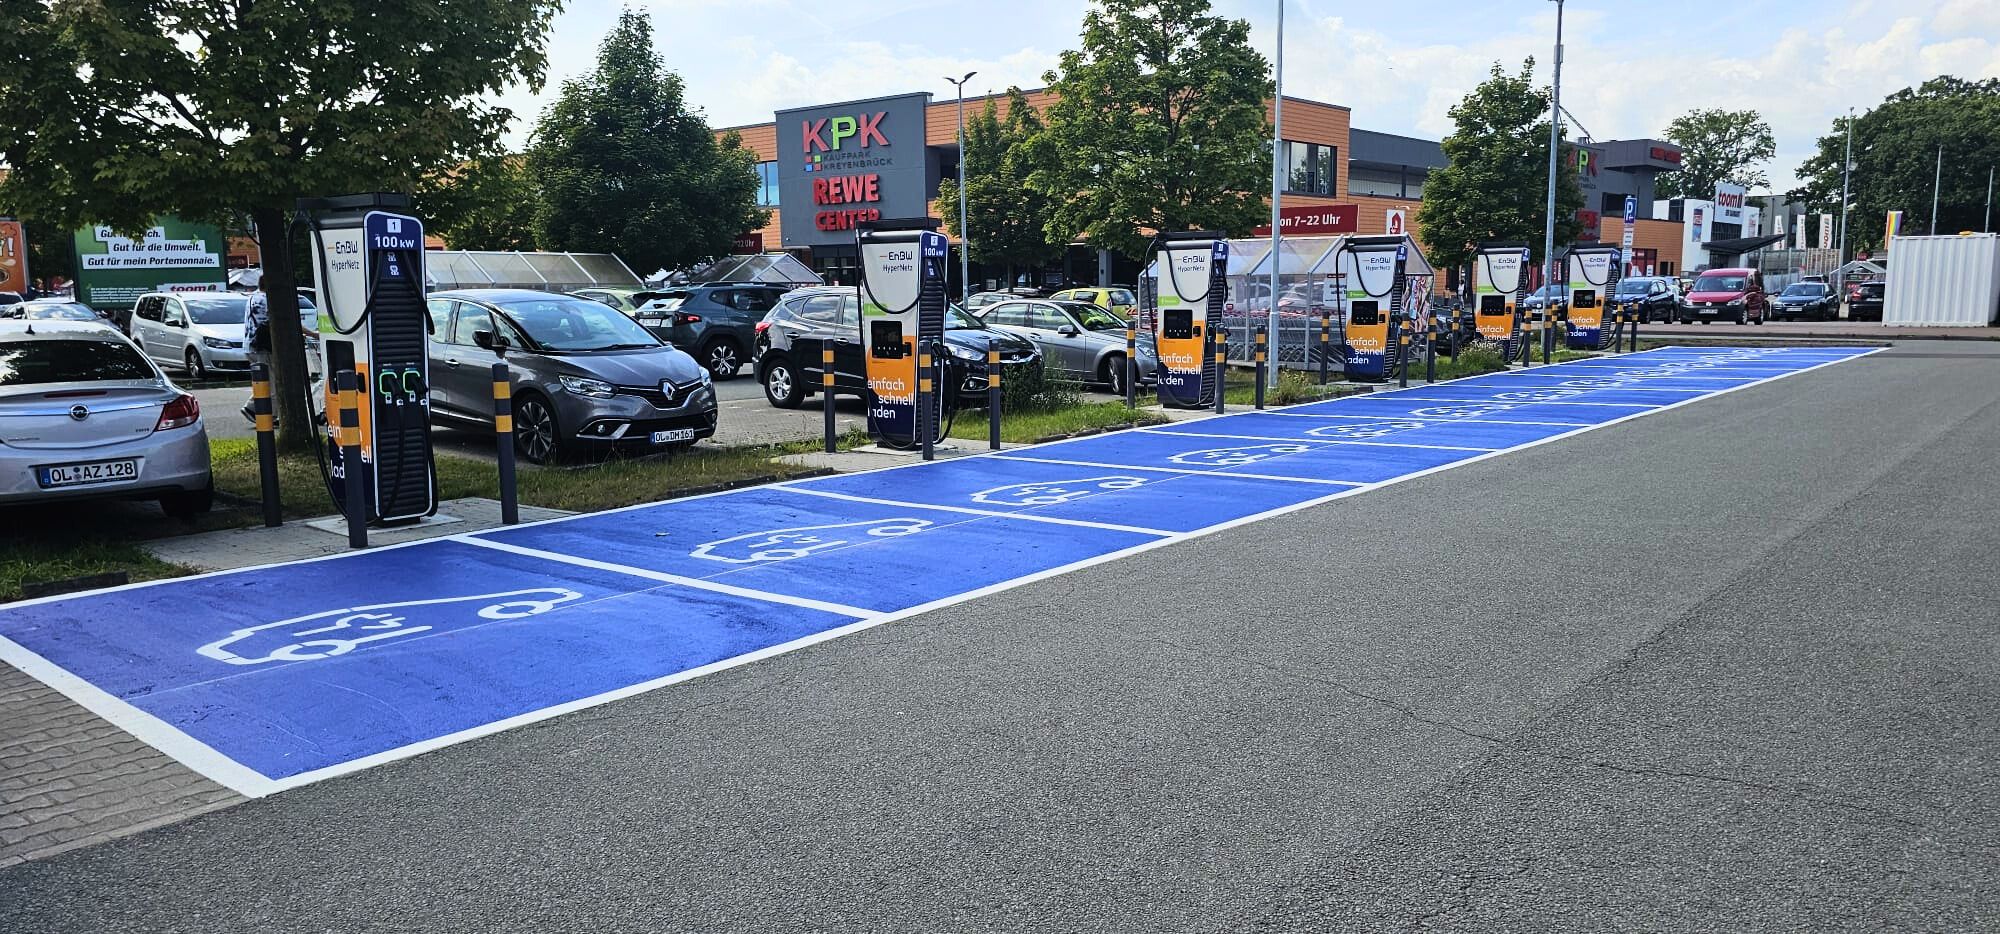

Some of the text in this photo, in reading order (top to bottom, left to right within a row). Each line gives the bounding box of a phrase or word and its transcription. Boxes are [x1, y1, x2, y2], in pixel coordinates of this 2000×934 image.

[802, 111, 889, 152] KPK
[813, 174, 879, 205] REWE
[1626, 202, 1633, 221] P
[1279, 218, 1291, 227] on
[1322, 213, 1341, 225] Uhr
[113, 241, 202, 252] Gut für die Umwelt.
[335, 241, 359, 254] EnBW
[375, 236, 415, 248] 100 kW
[888, 251, 913, 261] EnBW
[924, 248, 936, 256] 100
[87, 254, 215, 266] Gut für mein Portemonnaie.
[331, 258, 360, 272] HyperNetz
[1182, 255, 1206, 263] EnBW
[882, 264, 913, 273] HyperNetz
[1345, 337, 1378, 346] einfach
[1354, 347, 1385, 356] schnell
[1158, 353, 1193, 364] einfach
[1167, 364, 1201, 375] schnell
[867, 376, 905, 391] einfach
[878, 392, 914, 406] schnell
[656, 432, 665, 442] OL
[680, 429, 693, 439] 161
[51, 462, 134, 482] OL AZ 128
